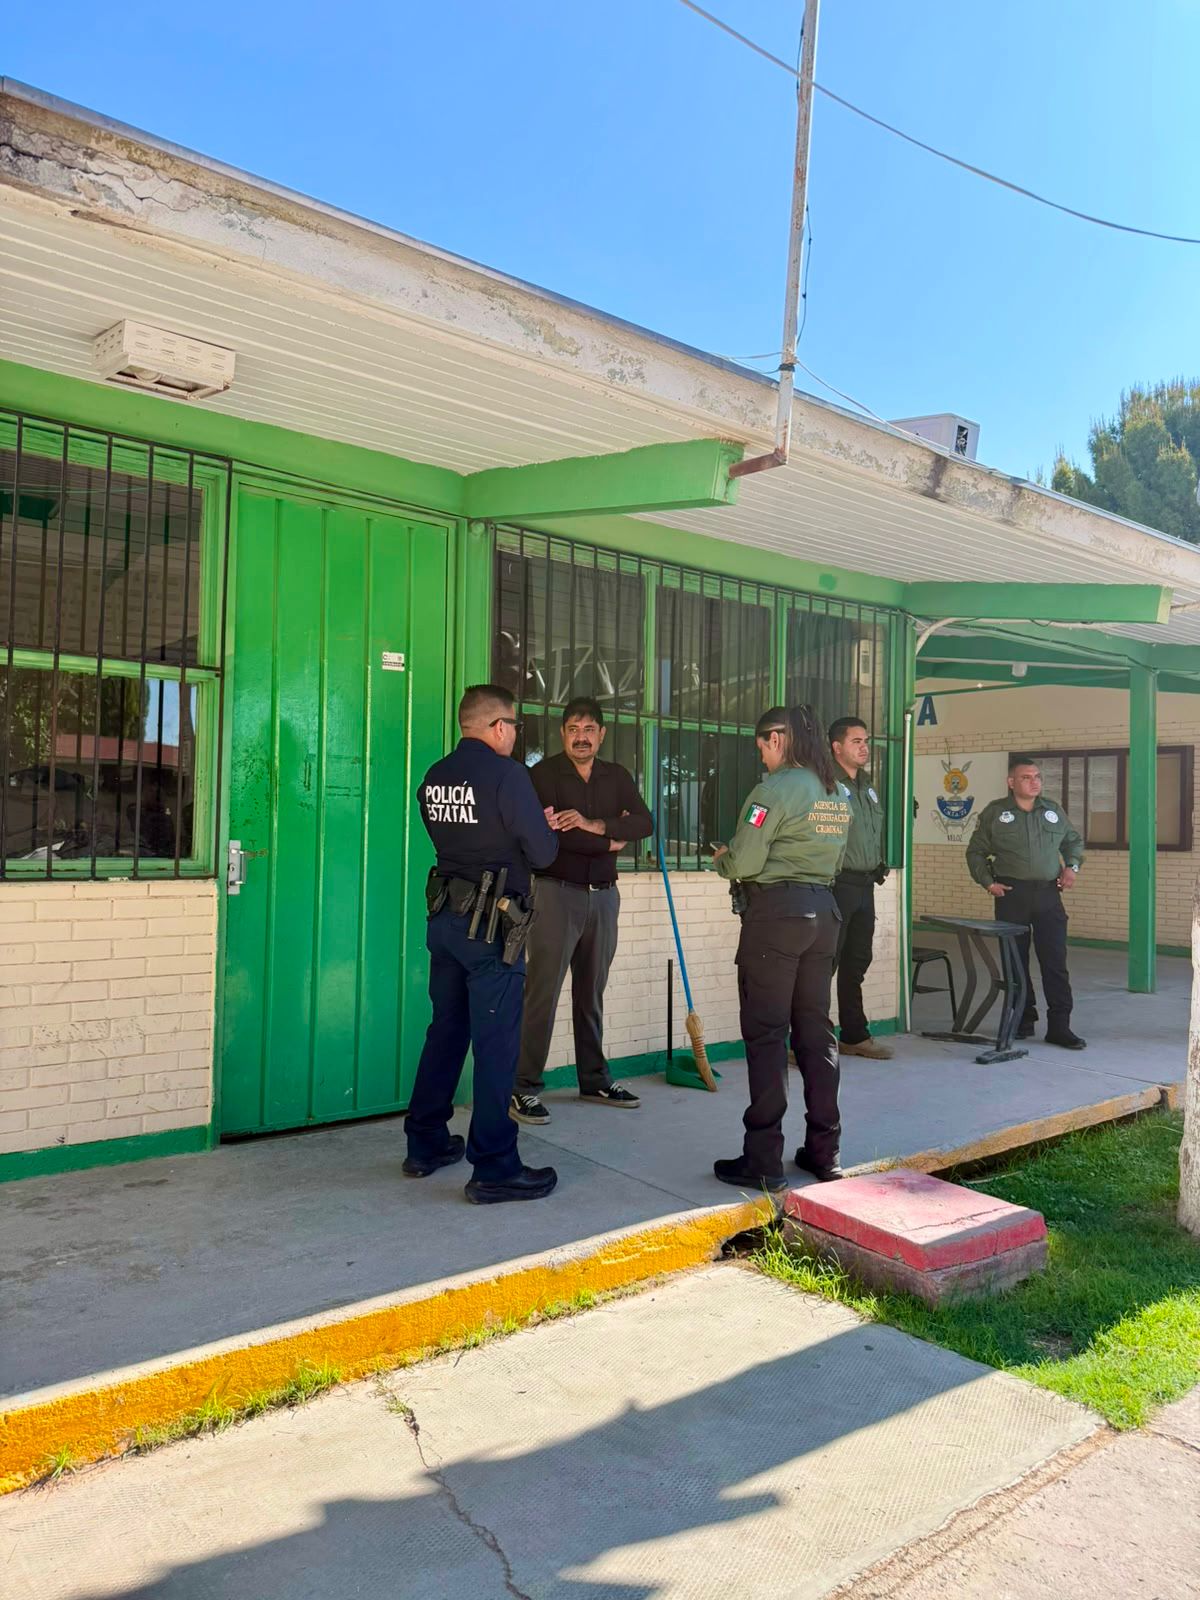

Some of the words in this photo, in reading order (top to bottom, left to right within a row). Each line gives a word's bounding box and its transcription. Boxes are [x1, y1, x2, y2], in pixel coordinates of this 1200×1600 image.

[917, 694, 938, 726] A
[425, 780, 476, 806] POLICÍA
[426, 803, 478, 824] ESTATAL
[813, 800, 839, 812] AGENCIA
[839, 802, 848, 812] DE
[815, 824, 843, 834] CRIMINAL
